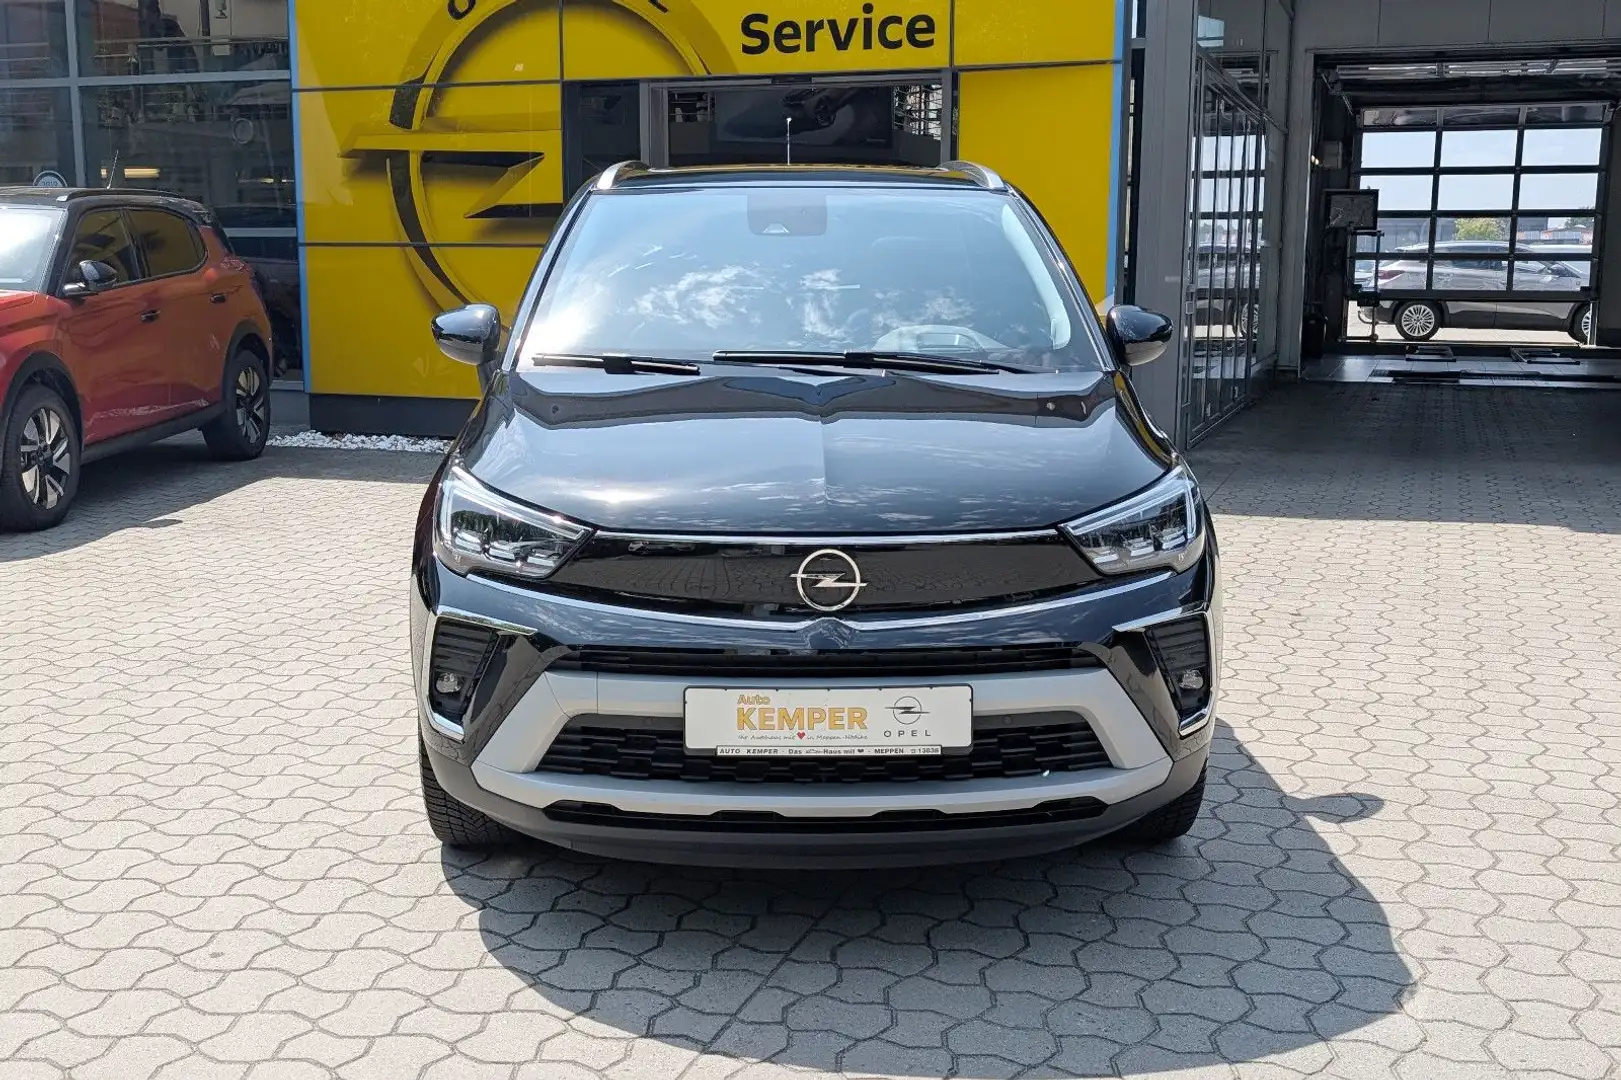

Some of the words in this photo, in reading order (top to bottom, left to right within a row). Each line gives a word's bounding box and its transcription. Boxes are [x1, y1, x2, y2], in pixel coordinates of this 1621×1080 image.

[741, 3, 935, 55] Service
[737, 694, 771, 705] Auto
[737, 707, 868, 730] KEMPER
[883, 729, 932, 738] OPEL
